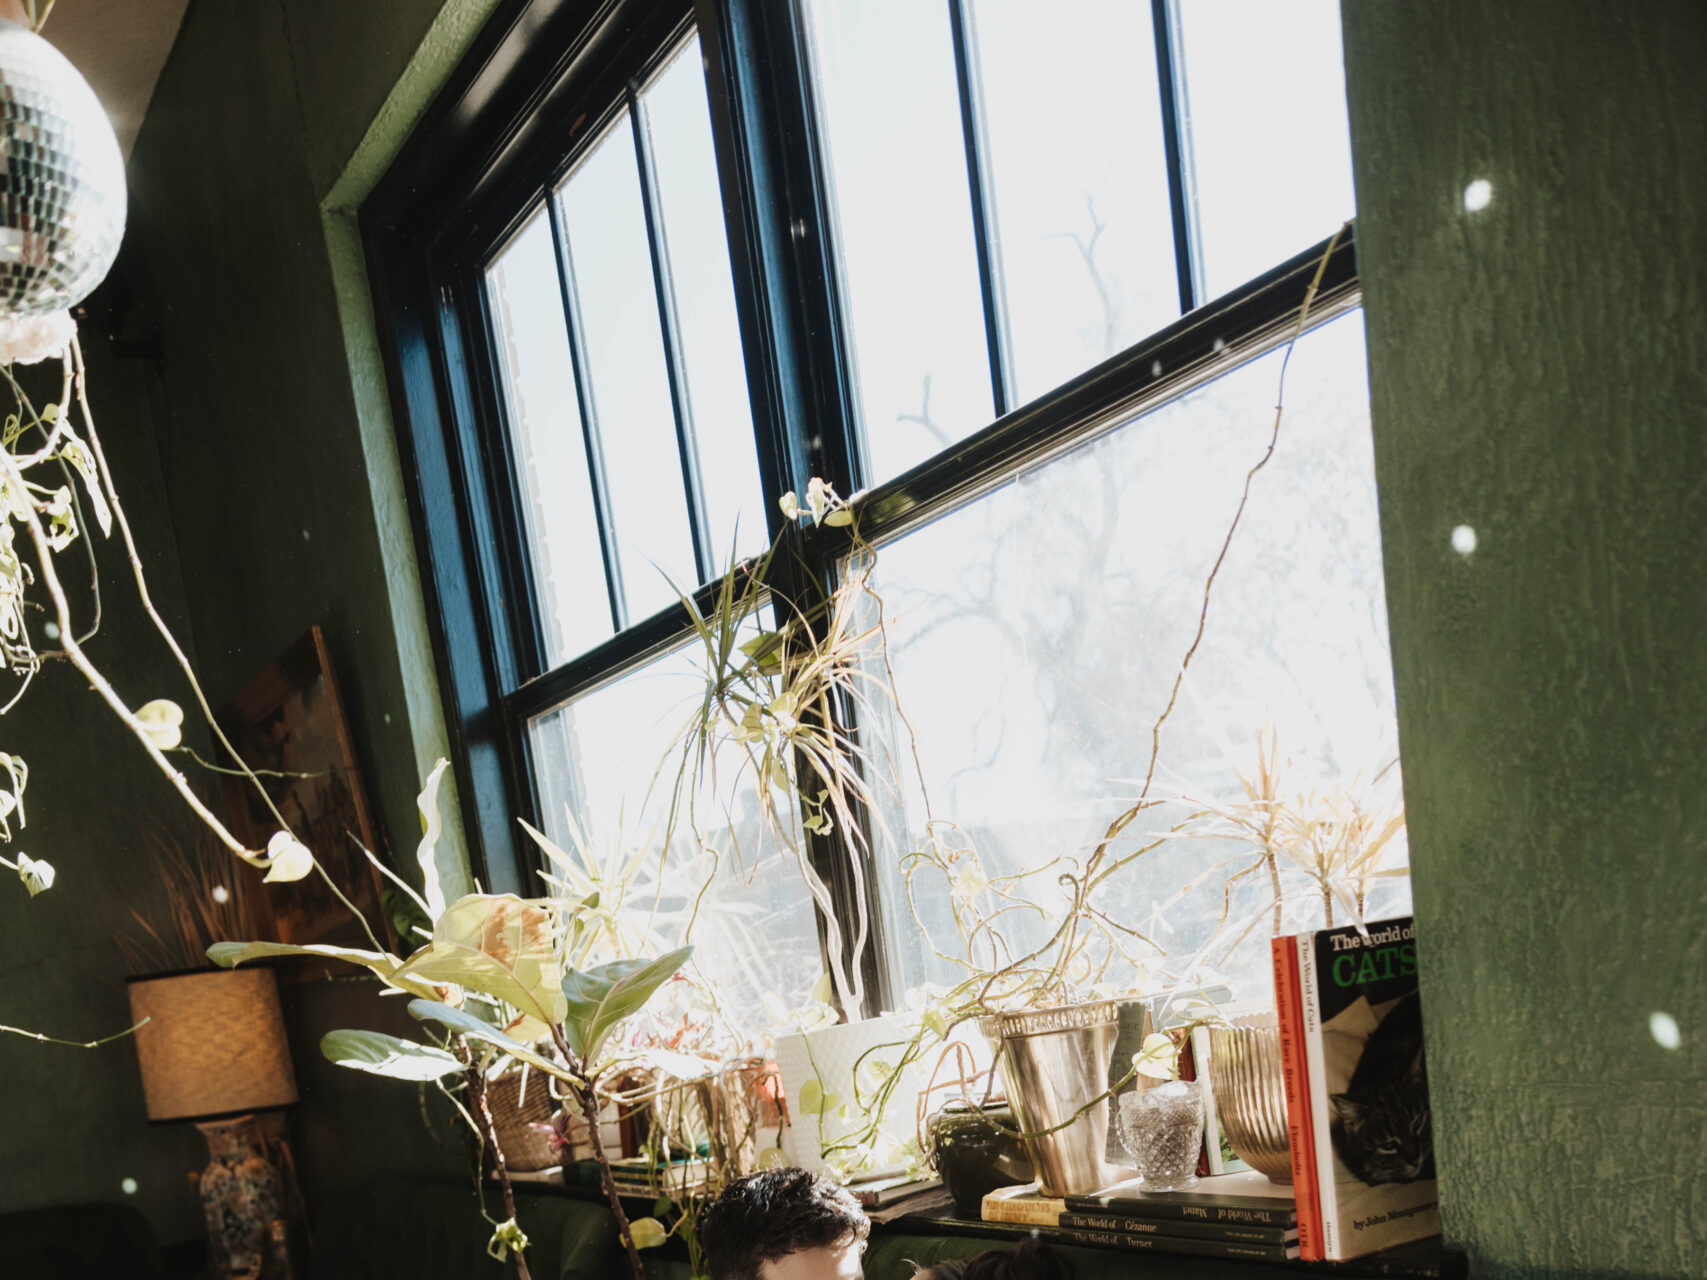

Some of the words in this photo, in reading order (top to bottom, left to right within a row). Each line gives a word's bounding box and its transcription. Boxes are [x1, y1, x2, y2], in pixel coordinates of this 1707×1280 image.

[1330, 933, 1360, 951] The
[1301, 941, 1310, 961] The
[1332, 944, 1418, 987] CATS
[1303, 962, 1313, 995] World
[1217, 1208, 1226, 1220] of
[1228, 1209, 1253, 1222] World
[1253, 1210, 1272, 1223] The
[1353, 1219, 1365, 1231] by
[1365, 1213, 1387, 1228] John
[1072, 1216, 1086, 1227] The
[1087, 1217, 1108, 1229] World
[1108, 1218, 1117, 1230] of
[1125, 1220, 1157, 1232] Cézanne
[1074, 1233, 1087, 1242] The
[1088, 1232, 1109, 1244] World
[1109, 1234, 1119, 1245] of
[1126, 1236, 1153, 1248] Turner
